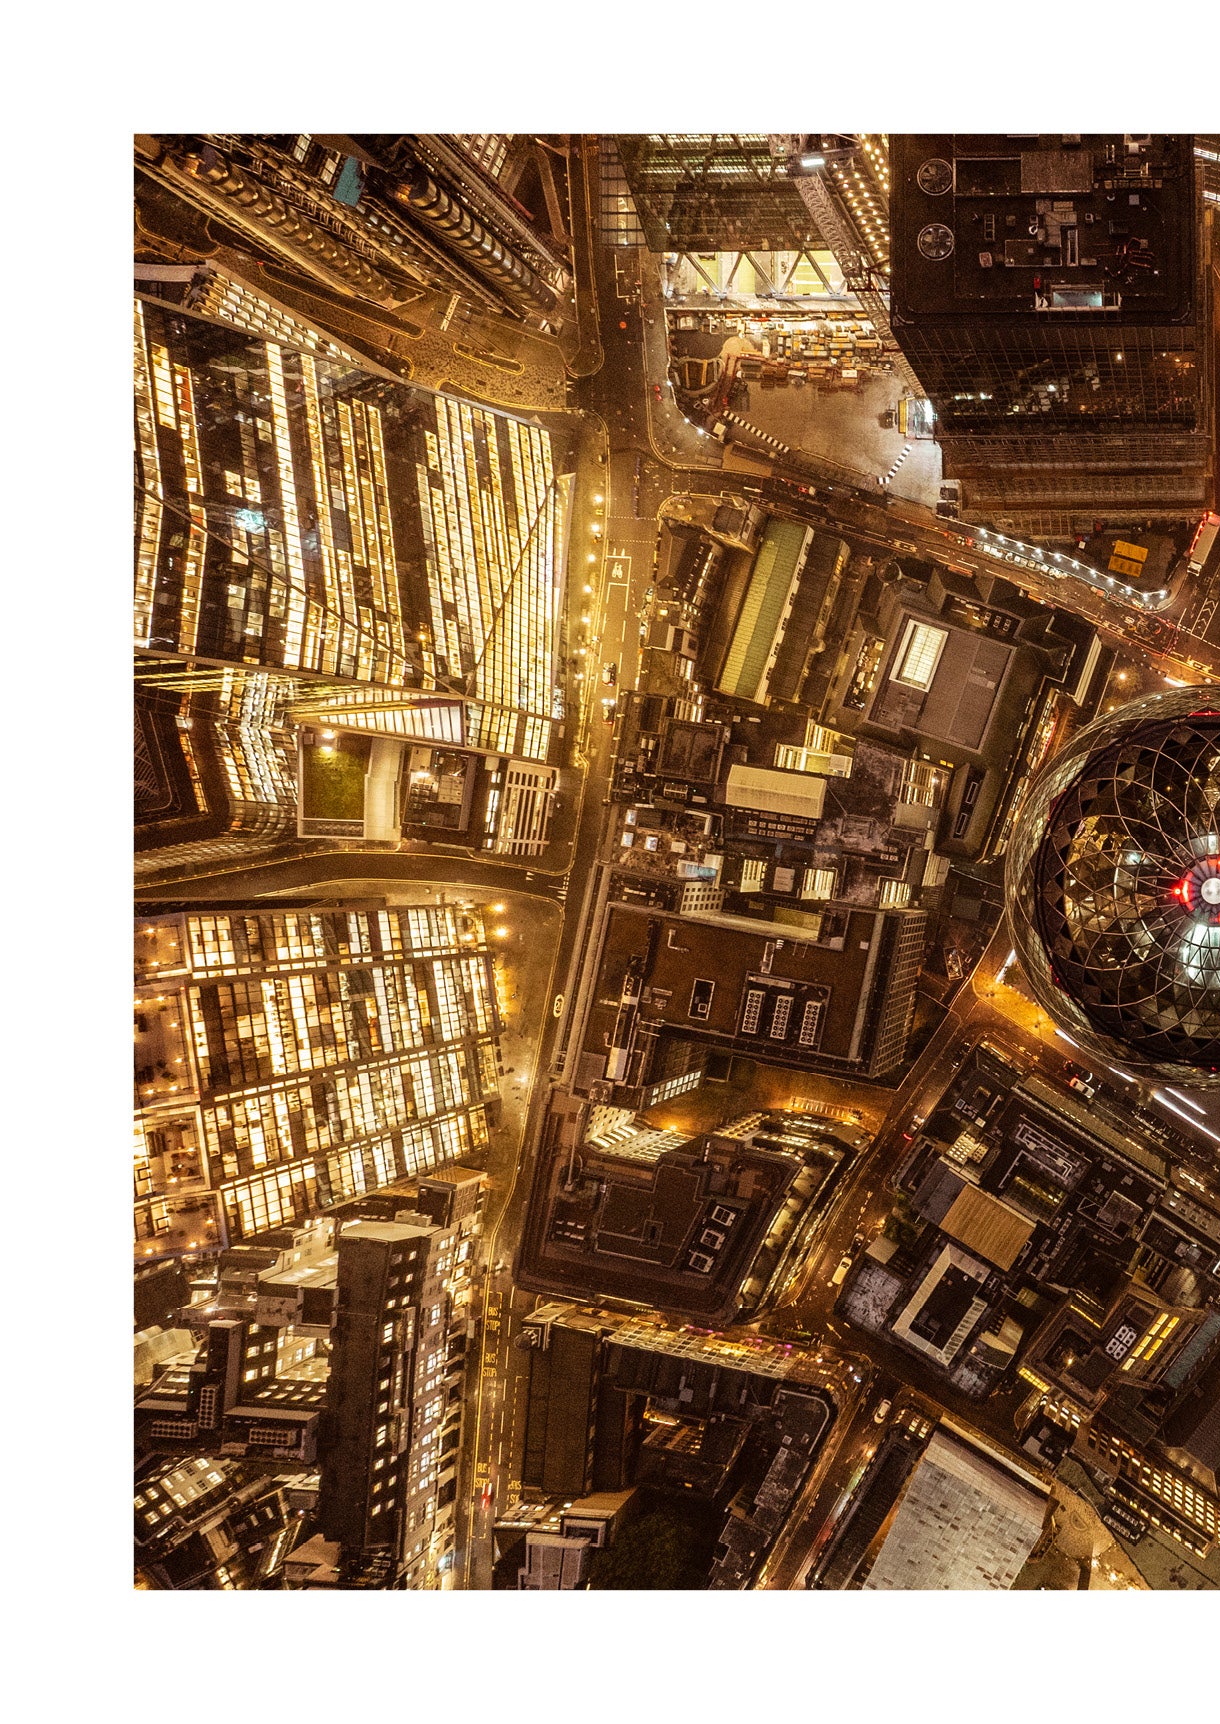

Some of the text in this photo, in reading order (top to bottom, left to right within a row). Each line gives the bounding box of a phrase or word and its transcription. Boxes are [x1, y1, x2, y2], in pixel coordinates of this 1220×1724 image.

[488, 1306, 498, 1316] BUS
[486, 1320, 500, 1331] STOP
[485, 1352, 496, 1363] BUS
